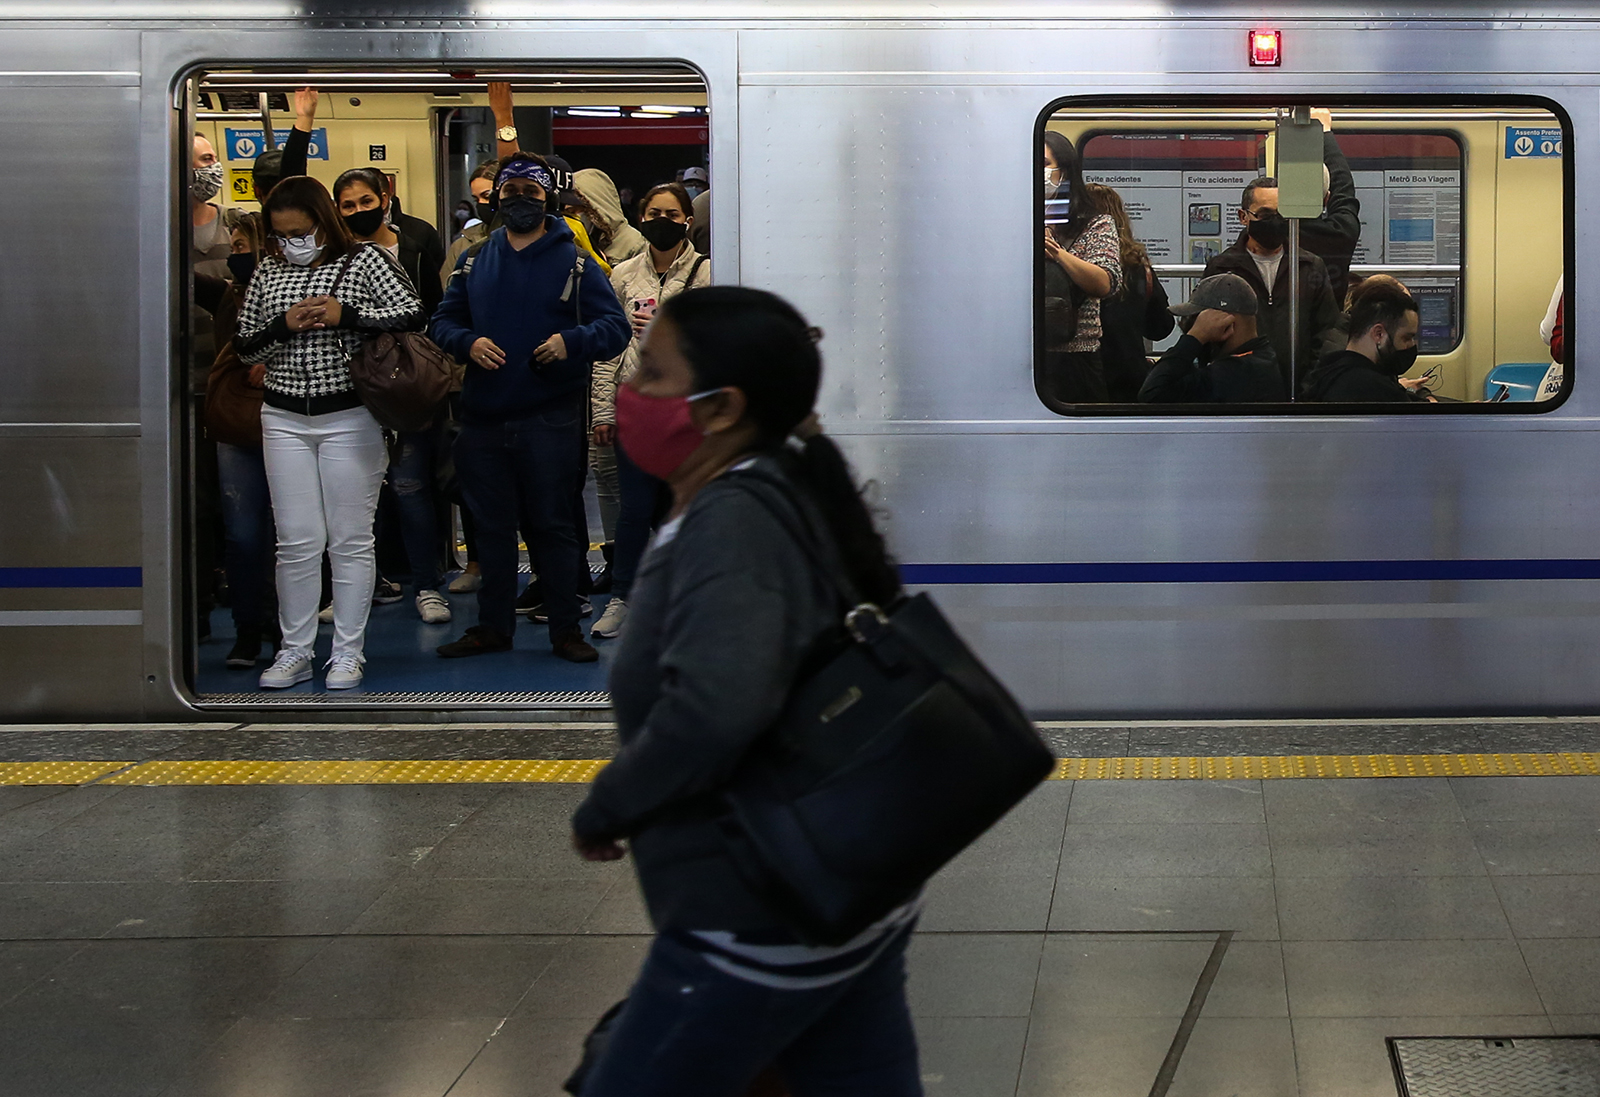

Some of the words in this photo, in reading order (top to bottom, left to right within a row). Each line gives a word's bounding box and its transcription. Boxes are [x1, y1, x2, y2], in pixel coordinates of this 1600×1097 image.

[372, 151, 383, 159] 26
[1389, 175, 1410, 183] Metrô
[1428, 175, 1455, 184] Viagem
